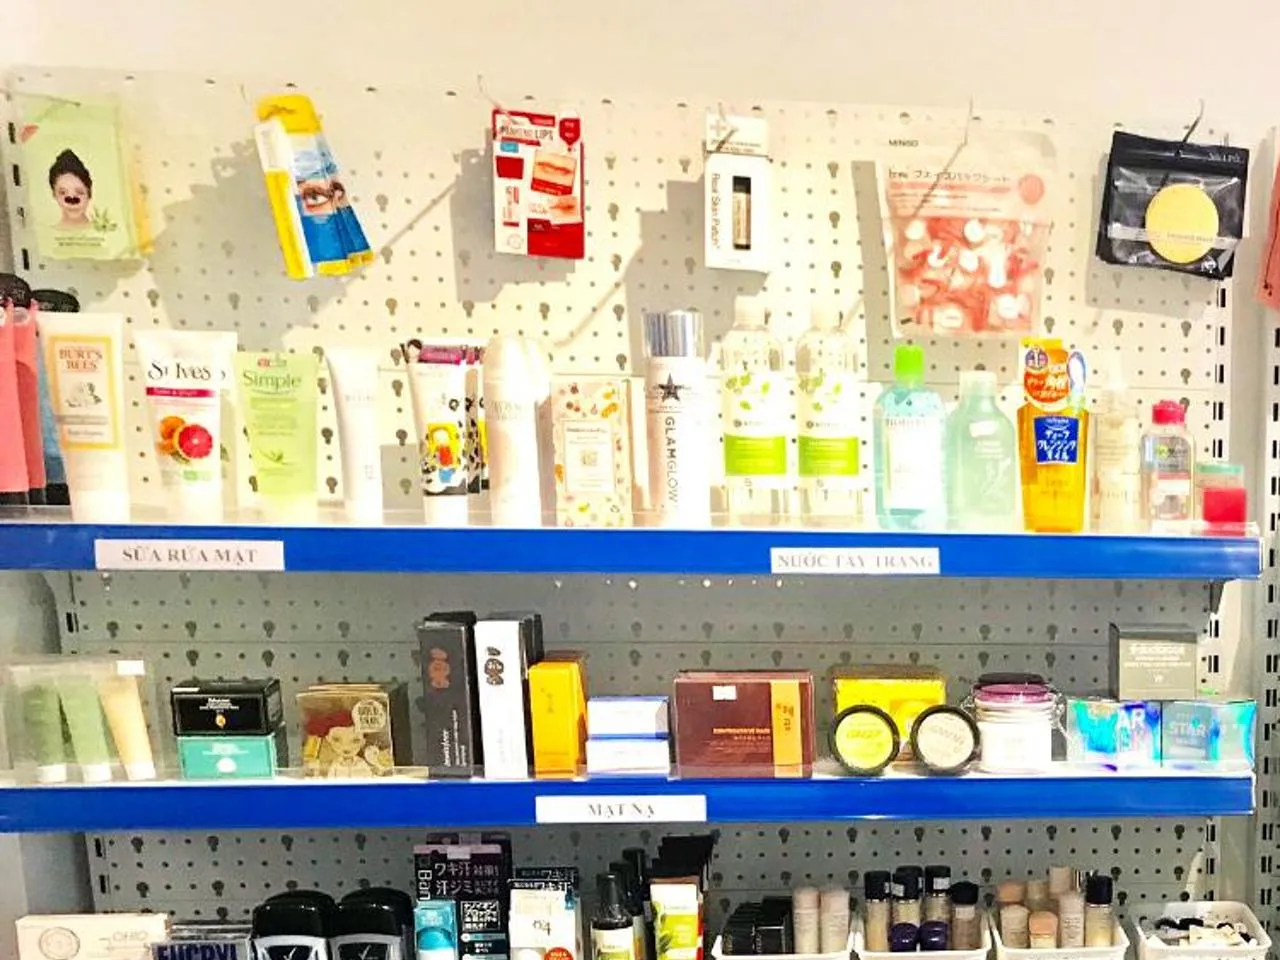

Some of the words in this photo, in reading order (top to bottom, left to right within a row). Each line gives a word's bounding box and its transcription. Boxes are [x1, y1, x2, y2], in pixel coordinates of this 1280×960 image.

[242, 370, 302, 392] Simple
[664, 416, 680, 503] GLAMGLOW
[417, 868, 433, 902] Ban
